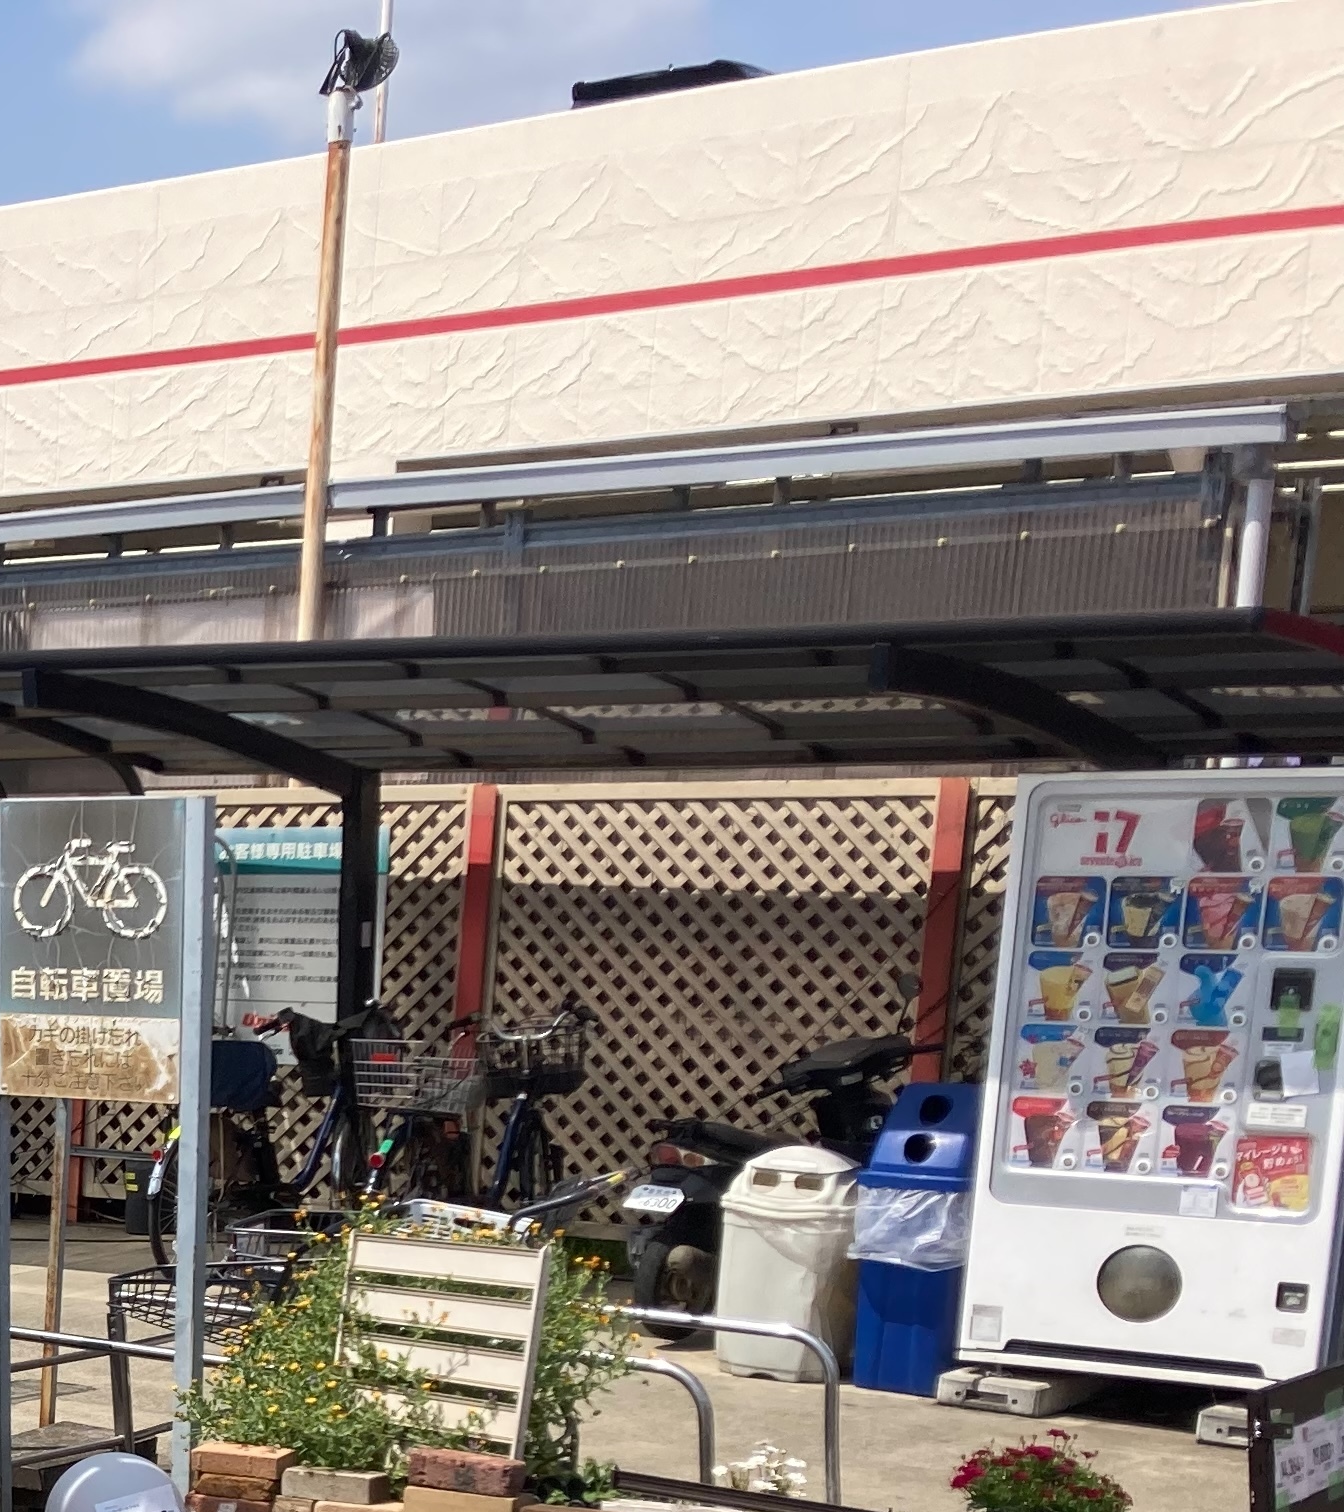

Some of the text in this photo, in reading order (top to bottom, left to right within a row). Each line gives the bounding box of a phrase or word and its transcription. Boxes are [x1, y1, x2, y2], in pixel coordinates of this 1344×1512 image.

[11, 966, 163, 1004] 自転車置場
[29, 1026, 142, 1046] カギの掛け忘れ
[35, 1048, 132, 1069] 置き忘れには
